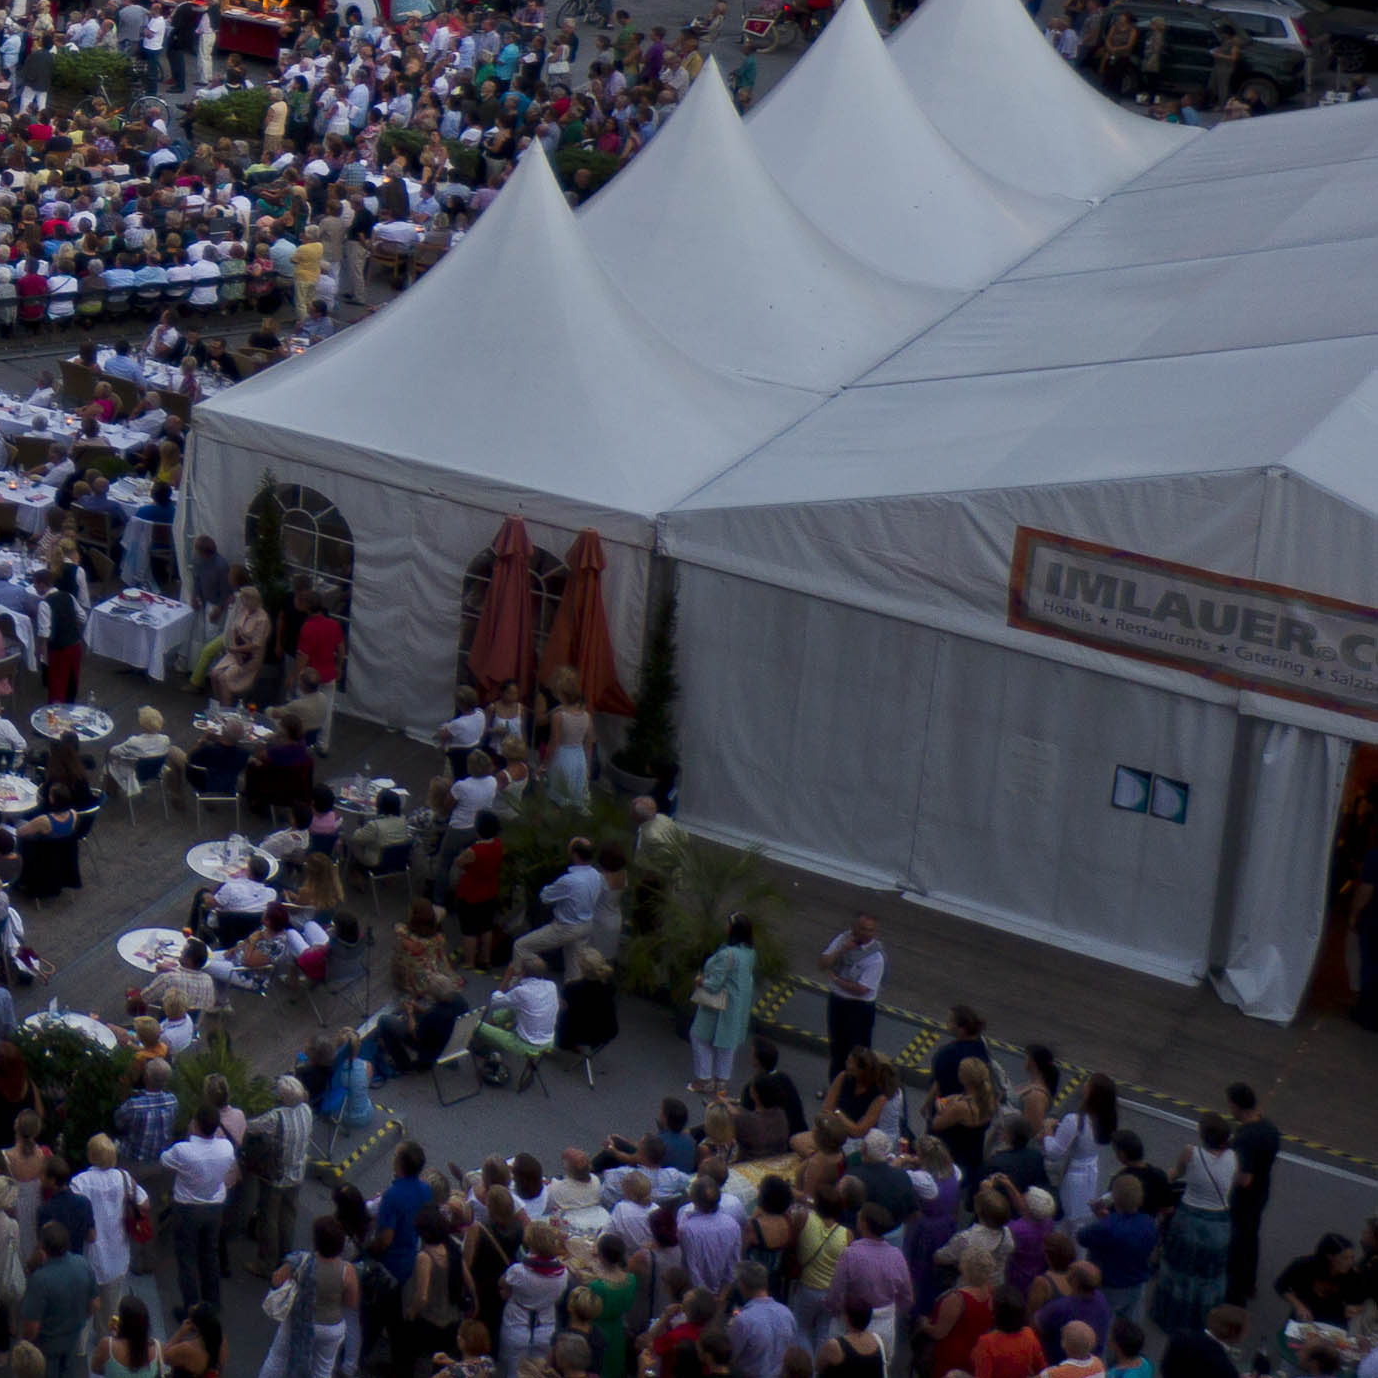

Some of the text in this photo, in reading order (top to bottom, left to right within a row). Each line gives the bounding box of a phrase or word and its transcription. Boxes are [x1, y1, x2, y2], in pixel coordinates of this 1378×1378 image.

[1043, 599, 1093, 623] Hotels
[1115, 617, 1212, 651] Restaurants
[1234, 646, 1305, 677] Catering
